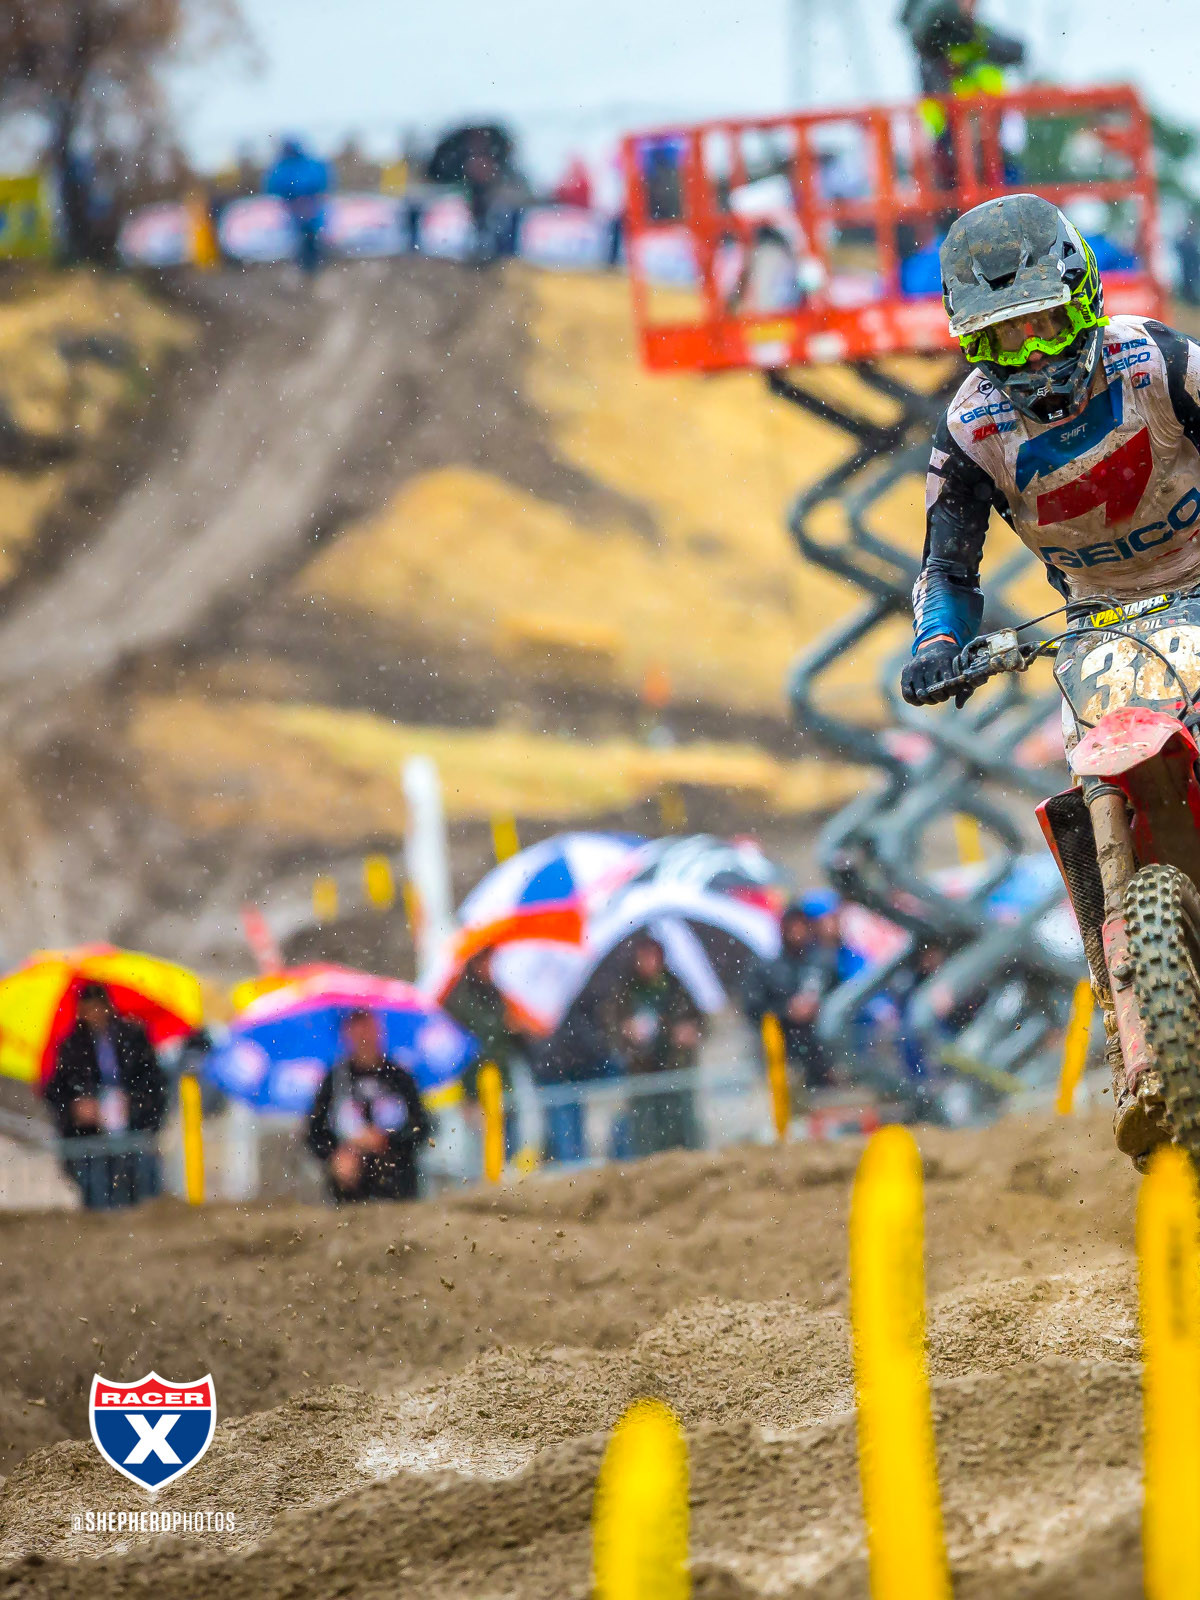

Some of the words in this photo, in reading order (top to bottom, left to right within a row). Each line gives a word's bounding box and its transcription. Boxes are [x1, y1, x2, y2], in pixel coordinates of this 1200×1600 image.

[1104, 351, 1151, 377] GEICO
[960, 400, 1014, 424] GEICO
[1060, 422, 1088, 442] SHIFT
